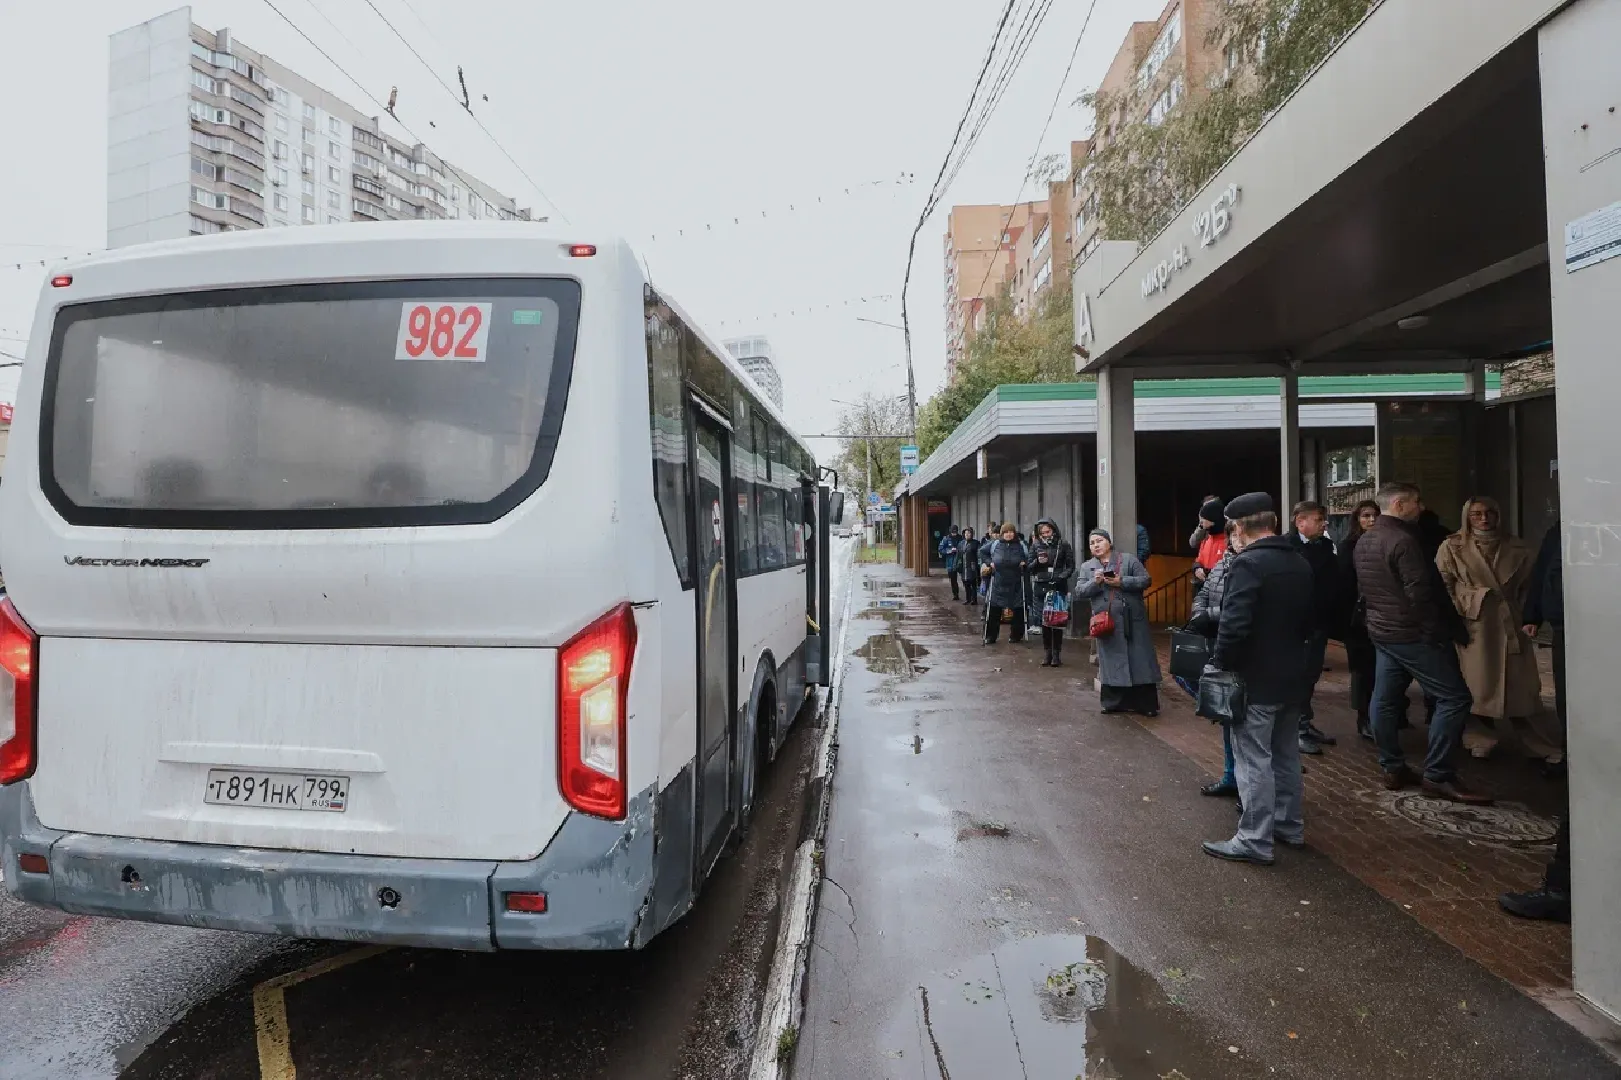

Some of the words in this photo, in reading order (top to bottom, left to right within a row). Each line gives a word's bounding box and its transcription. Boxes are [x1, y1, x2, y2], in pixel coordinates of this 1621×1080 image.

[405, 305, 482, 358] 982
[306, 778, 341, 799] 799
[311, 800, 330, 808] RUS
